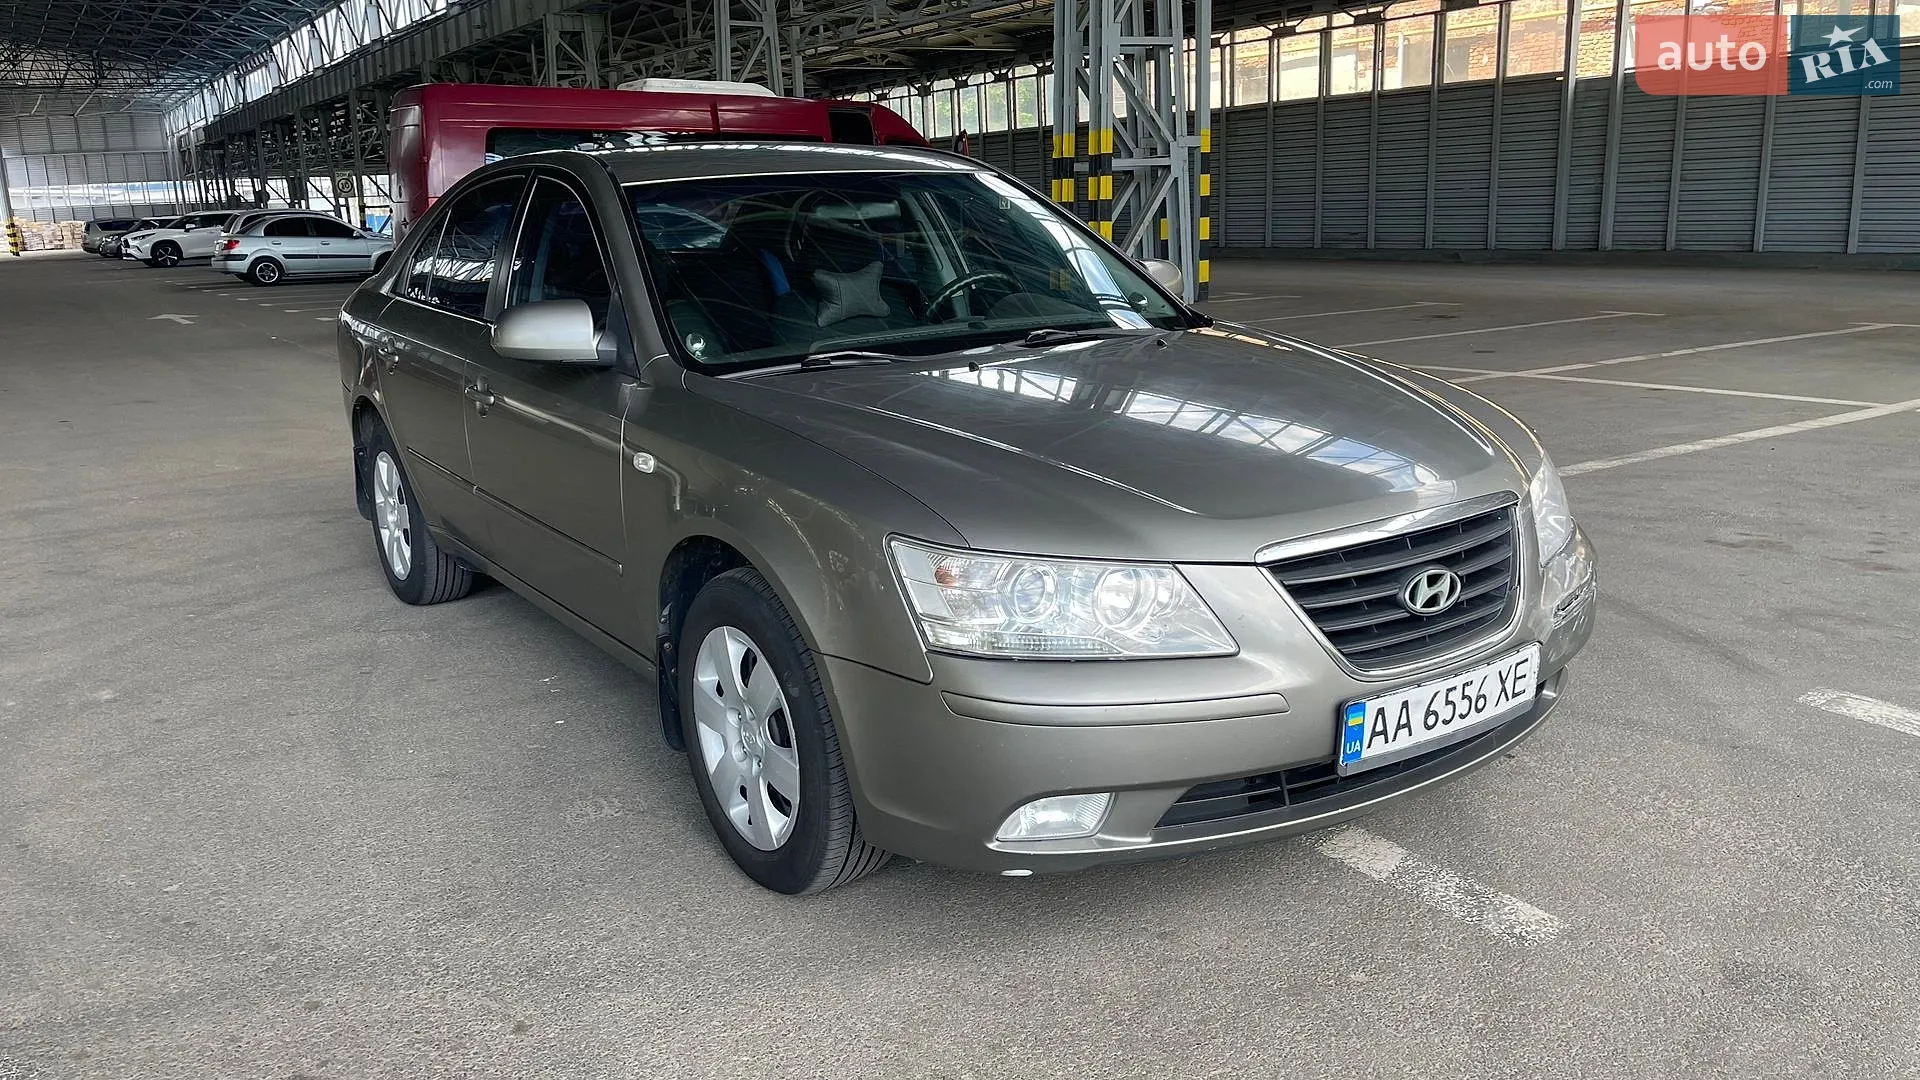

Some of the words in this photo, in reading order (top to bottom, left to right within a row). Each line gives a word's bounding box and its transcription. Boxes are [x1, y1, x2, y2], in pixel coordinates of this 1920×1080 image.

[1366, 699, 1413, 749] AA
[1423, 675, 1488, 731] 6556
[1495, 658, 1529, 708] XE
[1346, 742, 1361, 754] UA
